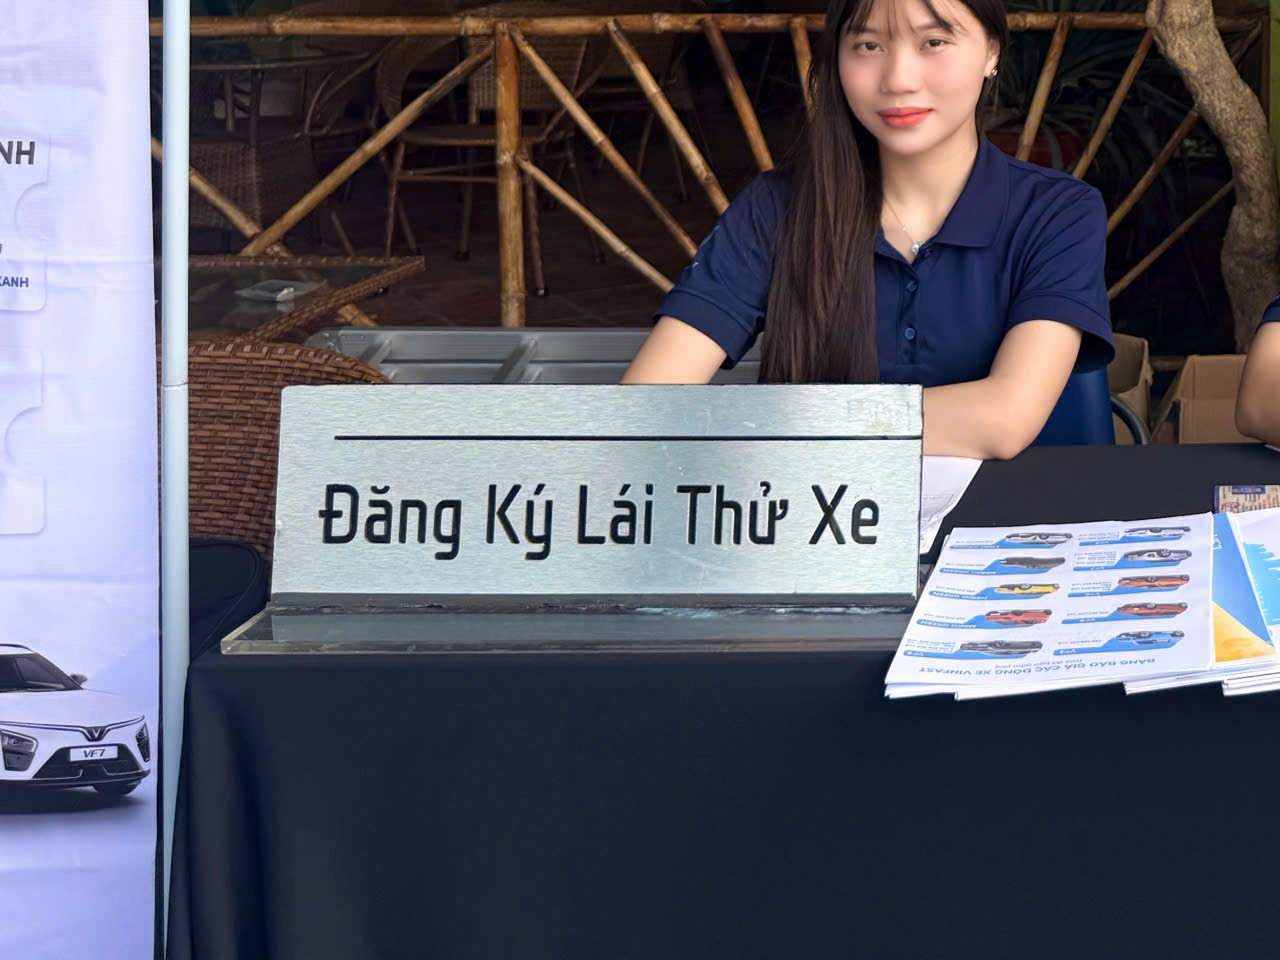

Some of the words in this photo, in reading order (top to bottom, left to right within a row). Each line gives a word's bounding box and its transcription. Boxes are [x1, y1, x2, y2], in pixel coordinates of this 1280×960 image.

[318, 483, 464, 561] Đăng
[485, 482, 555, 561] Ký
[576, 482, 655, 546] Lái
[676, 480, 790, 546] Thử
[808, 483, 881, 546] Xe
[83, 748, 106, 759] VF7
